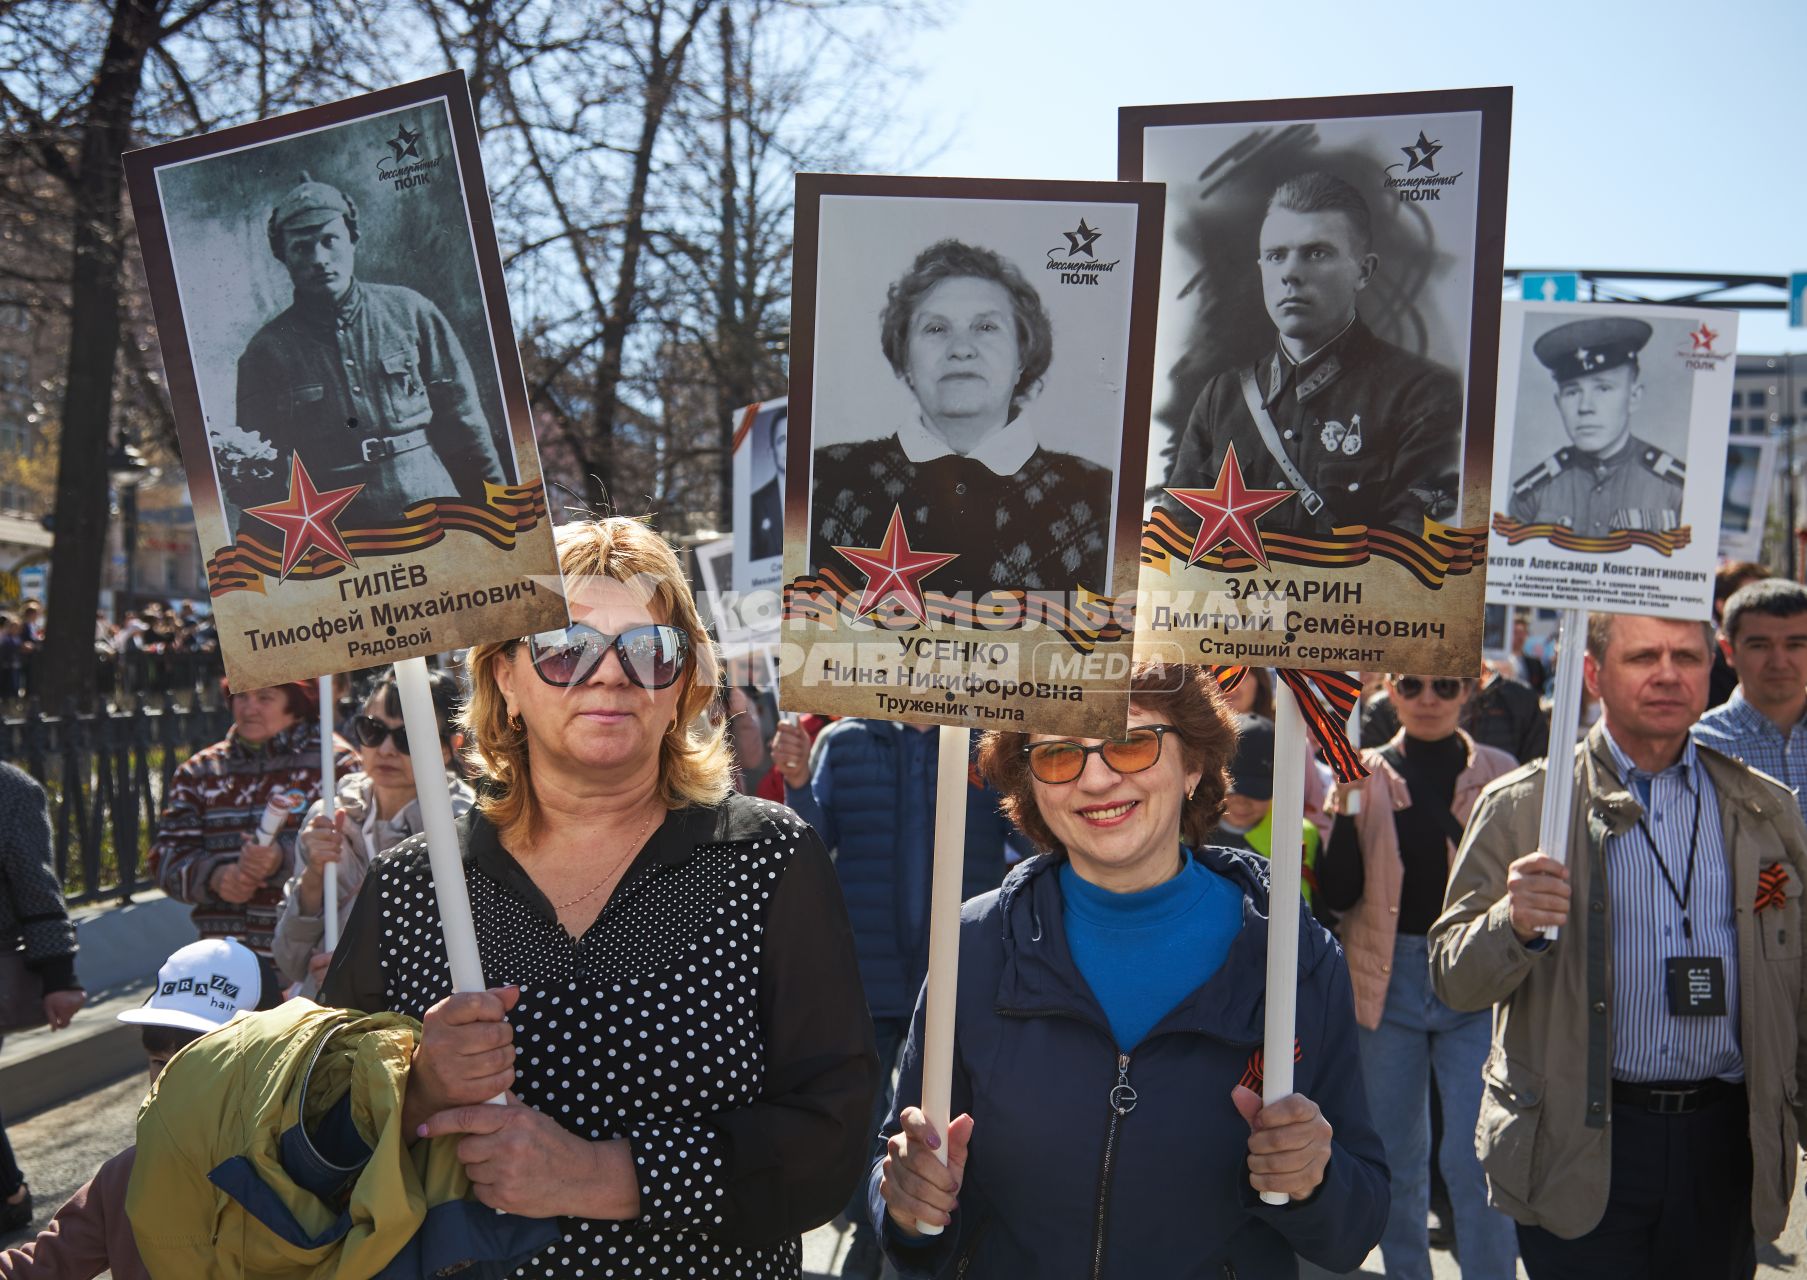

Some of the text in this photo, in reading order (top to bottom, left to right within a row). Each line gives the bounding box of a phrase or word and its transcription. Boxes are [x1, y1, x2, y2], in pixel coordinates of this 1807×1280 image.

[394, 173, 430, 191] ПОЛК
[1399, 188, 1440, 202] ПОЛК
[1046, 247, 1121, 273] бессмертный
[1060, 272, 1099, 285] ПОЛК
[338, 564, 427, 601] ГИЛЁВ
[1529, 556, 1598, 574] Александр
[1602, 562, 1708, 583] Константинович
[1224, 577, 1363, 604] ЗАХАРИН
[244, 579, 537, 652] Тимофей Михайлович
[1151, 606, 1446, 640] Дмитрий Семёнович
[348, 628, 432, 658] Рядовой
[897, 636, 1009, 665] УСЕНКО
[1199, 637, 1385, 663] Старший сержант
[823, 659, 1084, 702] Нина Никифоровна
[876, 692, 1025, 722] Труженик тыла
[210, 996, 236, 1012] hair
